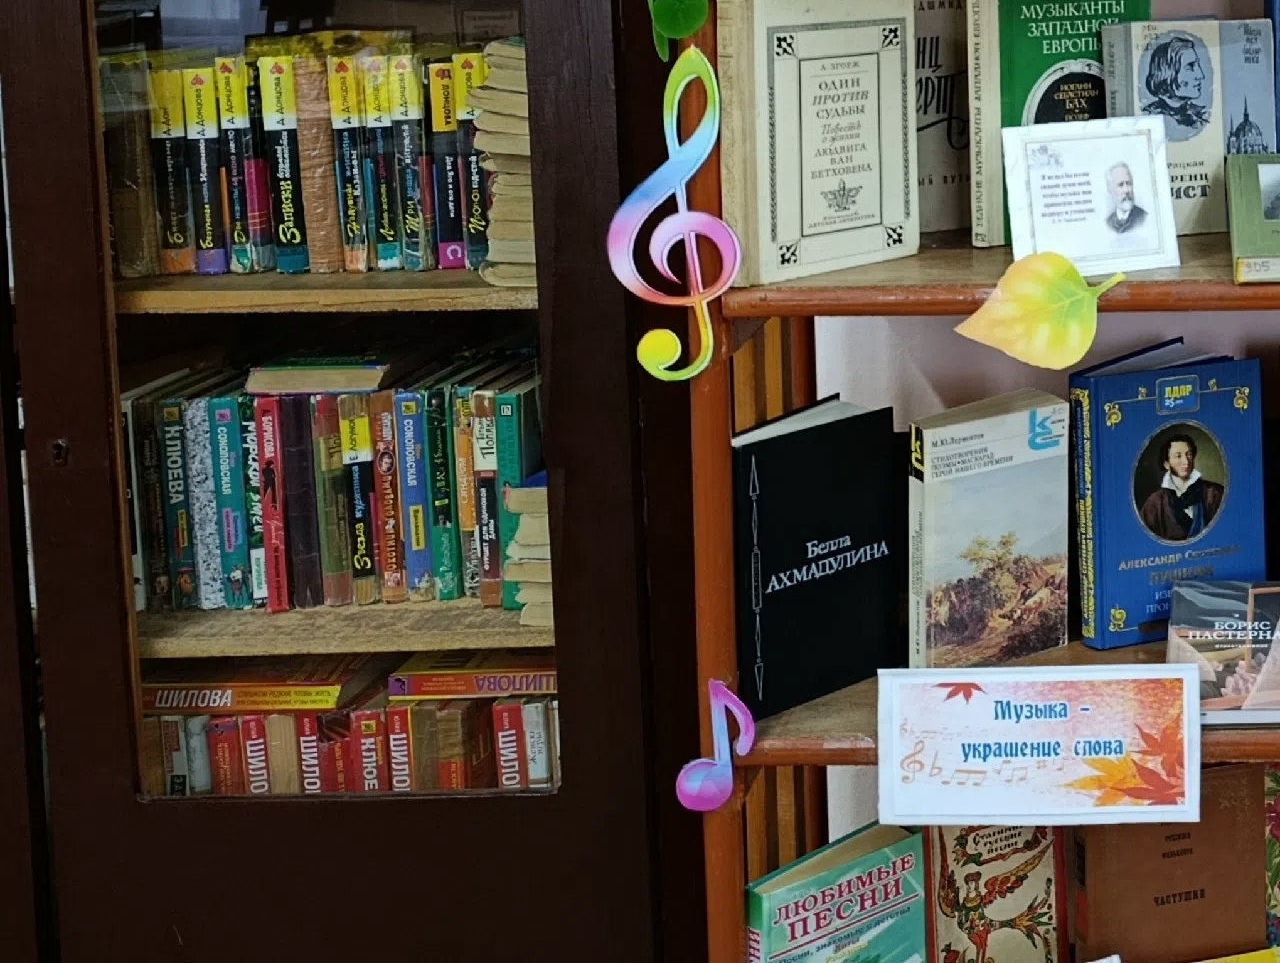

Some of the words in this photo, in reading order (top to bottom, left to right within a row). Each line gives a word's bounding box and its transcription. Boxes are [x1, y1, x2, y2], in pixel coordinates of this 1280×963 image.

[1021, 0, 1124, 19] МУЗЫКАНТЫ
[224, 75, 234, 114] Донцова
[274, 77, 285, 114] Донцова
[819, 78, 860, 91] ОДИН
[195, 89, 205, 126] Донцова
[812, 91, 869, 106] ПРОТИВ
[1066, 99, 1087, 108] БАХ
[816, 105, 865, 119] СУДЬБЫ
[814, 143, 867, 157] ЛЮДВИГА
[830, 155, 853, 165] ВАН
[811, 164, 872, 179] БЕТХОВЕНА
[279, 180, 301, 243] Записки
[1165, 384, 1192, 398] ЛДПР
[262, 416, 275, 457] БОРИСОВА
[217, 427, 231, 495] СОКОЛОВСКАЯ
[404, 419, 417, 486] СОКОЛОВСКАЯ
[164, 426, 184, 504] КЛЮЕВА
[807, 535, 851, 557] Белла
[766, 540, 888, 593] АХМАДУЛИНА
[1118, 553, 1183, 571] АЛЕКСАНДР
[1214, 621, 1271, 630] БОРИС
[474, 674, 558, 693] ШИЛОВА
[156, 690, 232, 707] ШИЛОВА
[994, 701, 1068, 723] Музыка
[961, 741, 1061, 762] украшение
[1074, 740, 1123, 756] слова
[774, 853, 915, 925] ЛЮБИМЫЕ
[1153, 888, 1206, 907] ЧАСТУШКИ
[787, 877, 905, 942] ПЕСНИ
[873, 906, 912, 929] детства
